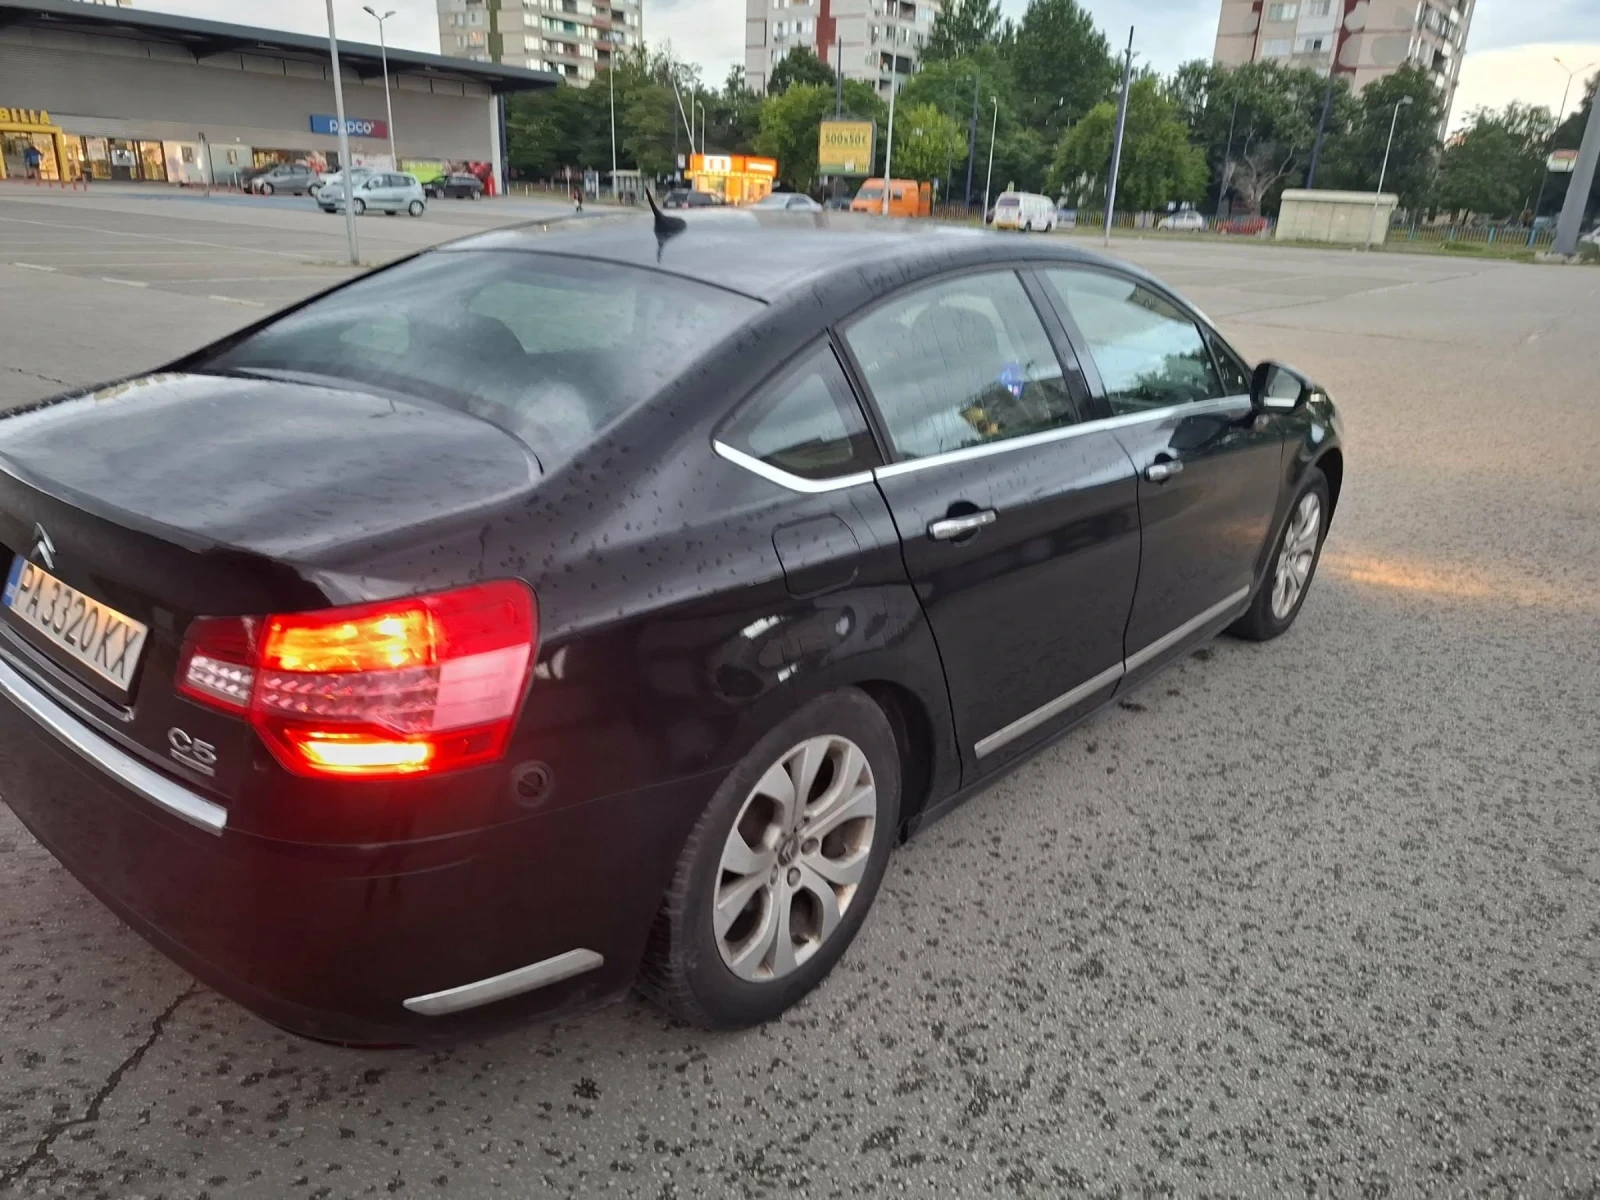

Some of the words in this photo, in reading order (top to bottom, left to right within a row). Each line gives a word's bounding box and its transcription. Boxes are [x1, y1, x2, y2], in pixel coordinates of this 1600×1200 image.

[0, 107, 51, 124] BILLA
[329, 119, 372, 134] ppco
[168, 727, 217, 764] C5
